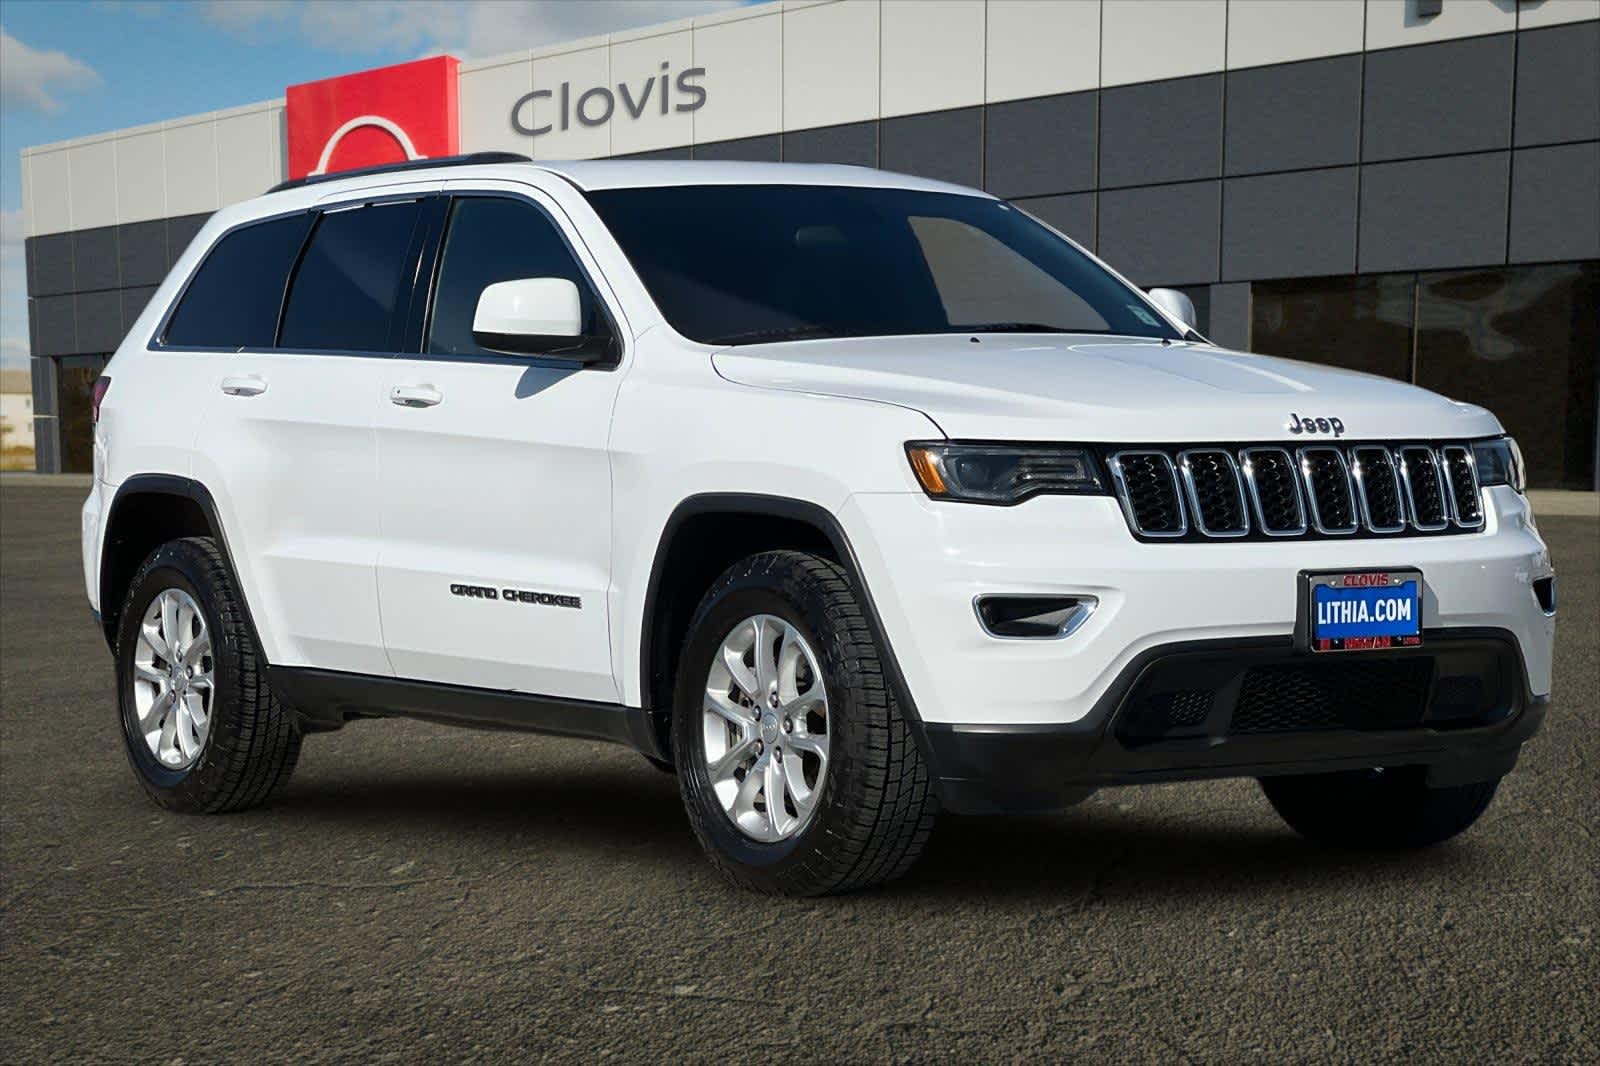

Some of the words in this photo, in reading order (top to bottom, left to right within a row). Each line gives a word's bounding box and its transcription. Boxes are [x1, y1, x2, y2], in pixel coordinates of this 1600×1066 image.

[511, 61, 707, 136] Clovis
[1288, 412, 1345, 438] Jeep
[1343, 573, 1389, 587] CLOVIS
[450, 583, 499, 600] GRAND
[502, 589, 582, 609] CHEROKEE
[1317, 598, 1412, 625] LITHIA.COM
